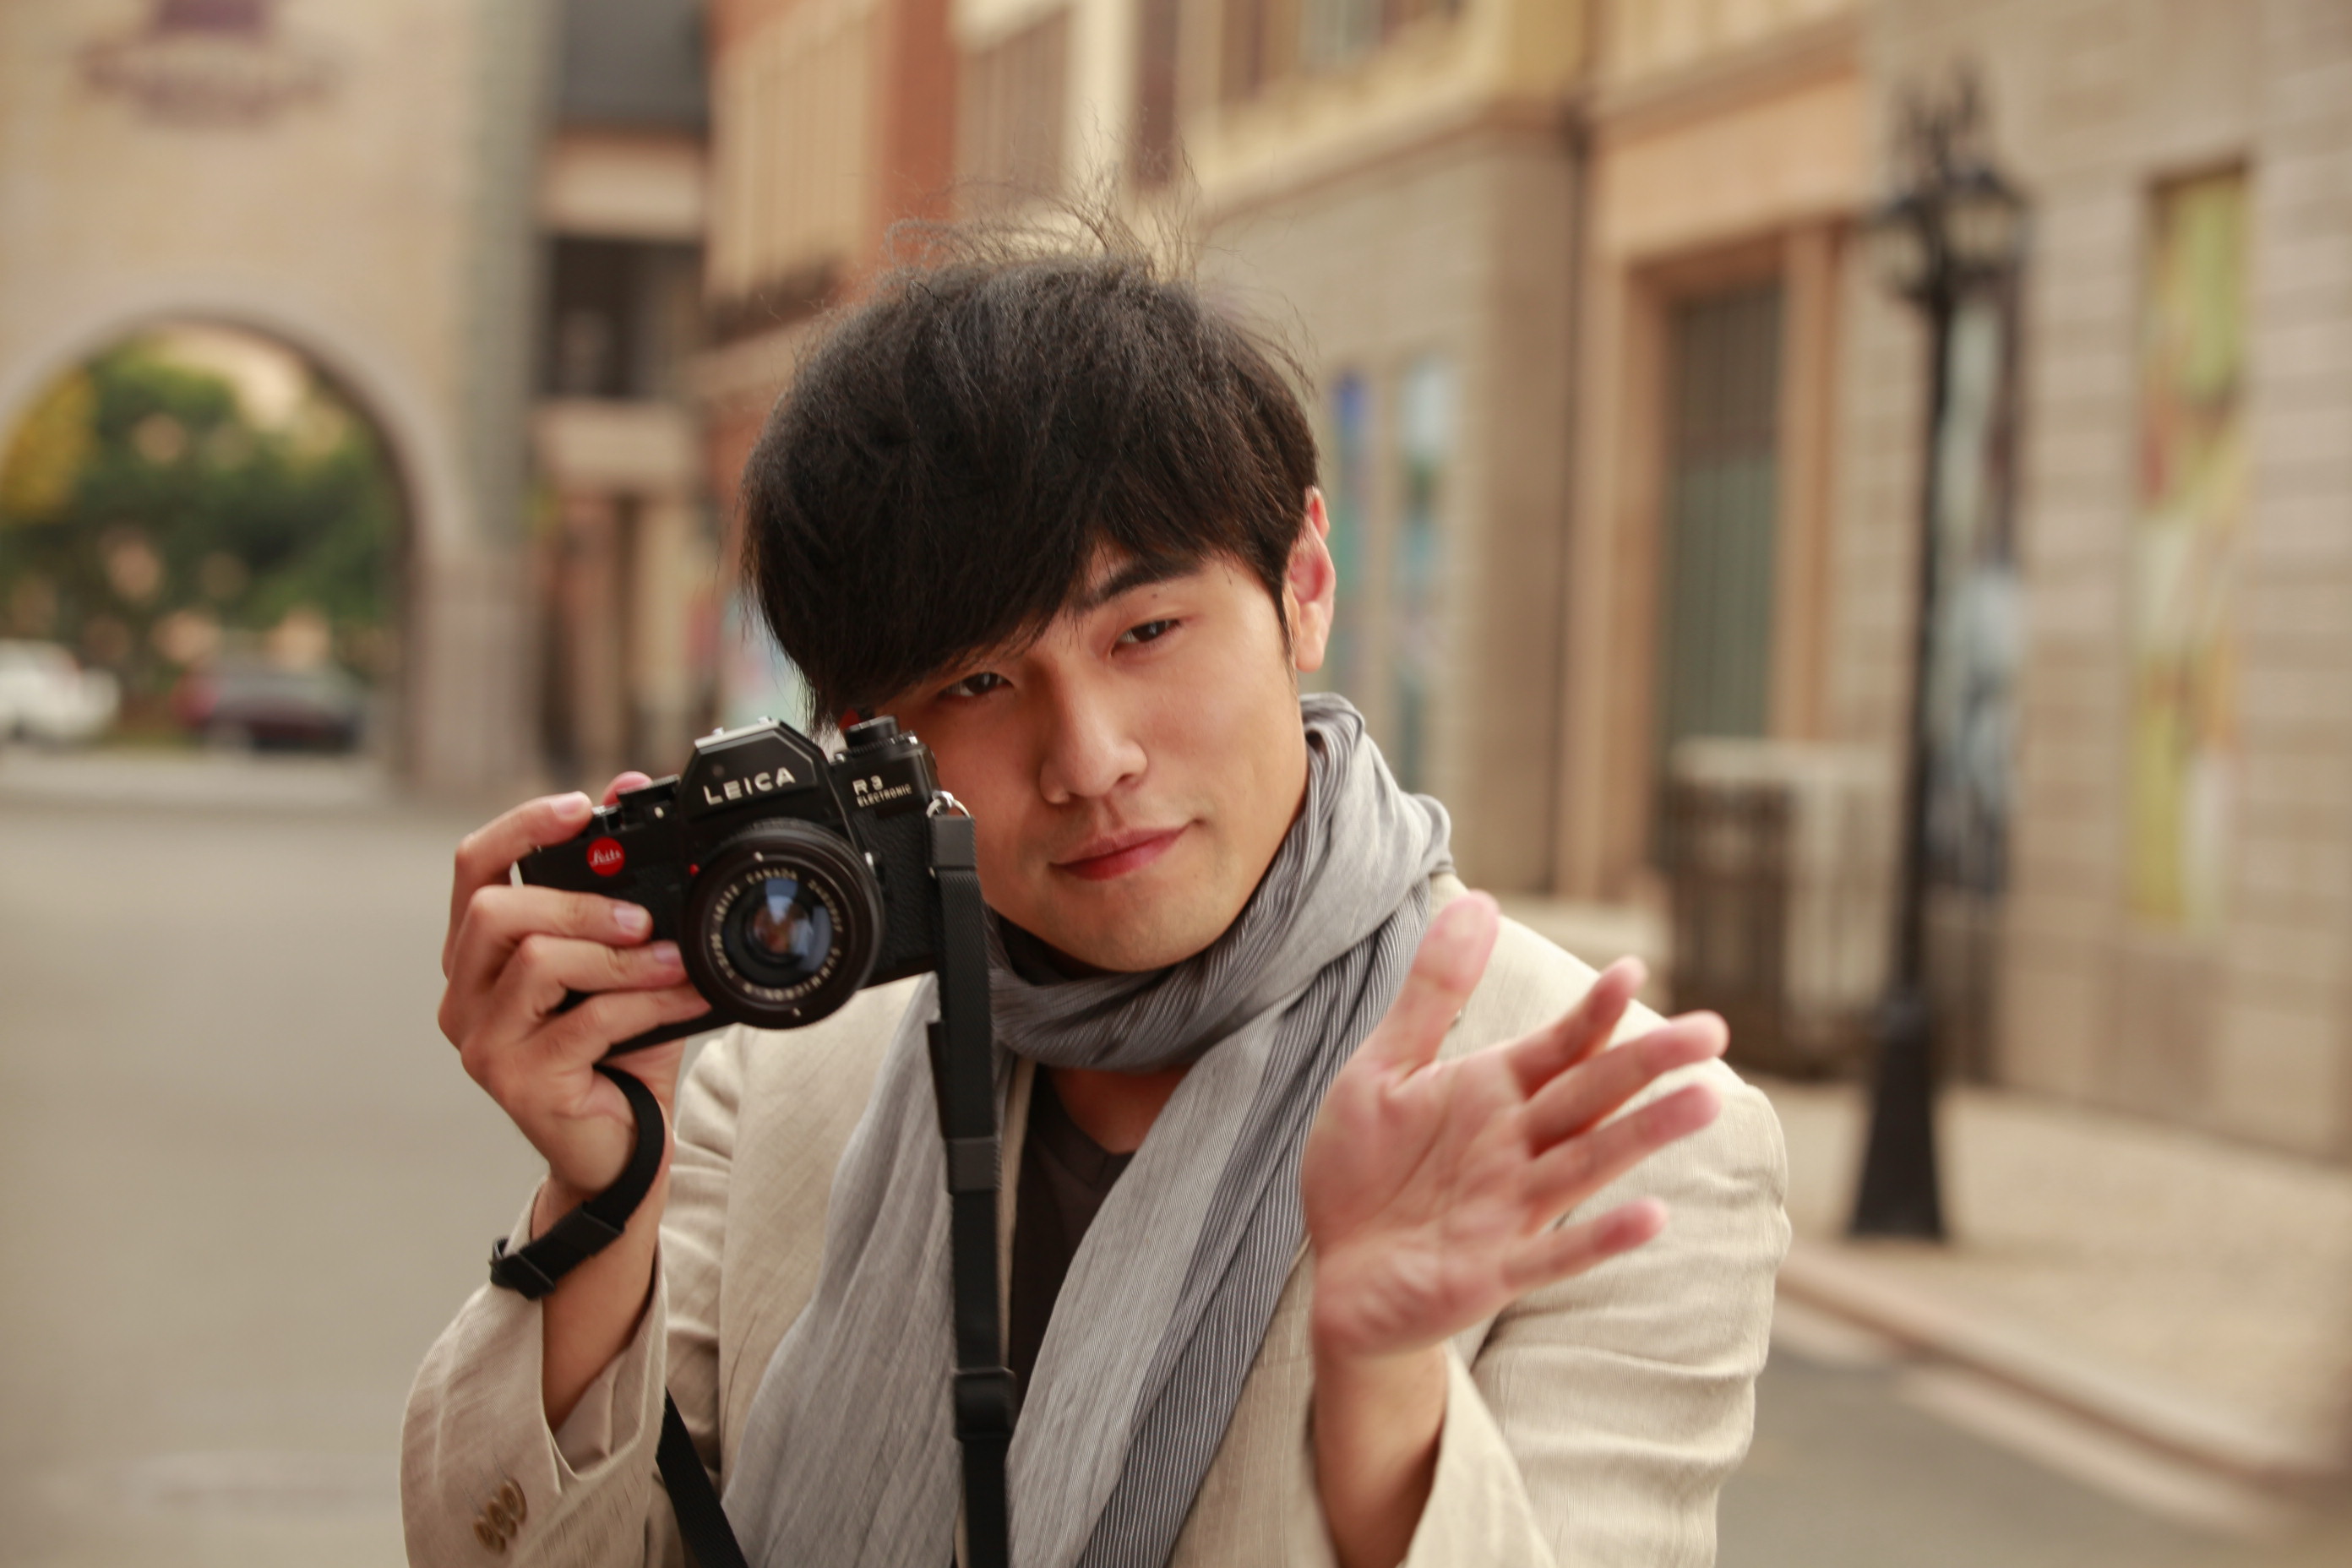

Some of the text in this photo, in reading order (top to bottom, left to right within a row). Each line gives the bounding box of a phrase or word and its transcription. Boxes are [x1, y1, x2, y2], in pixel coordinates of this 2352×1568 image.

[704, 766, 797, 805] LEICA
[857, 783, 912, 808] ELECTRONIC
[745, 868, 798, 885] CANADA
